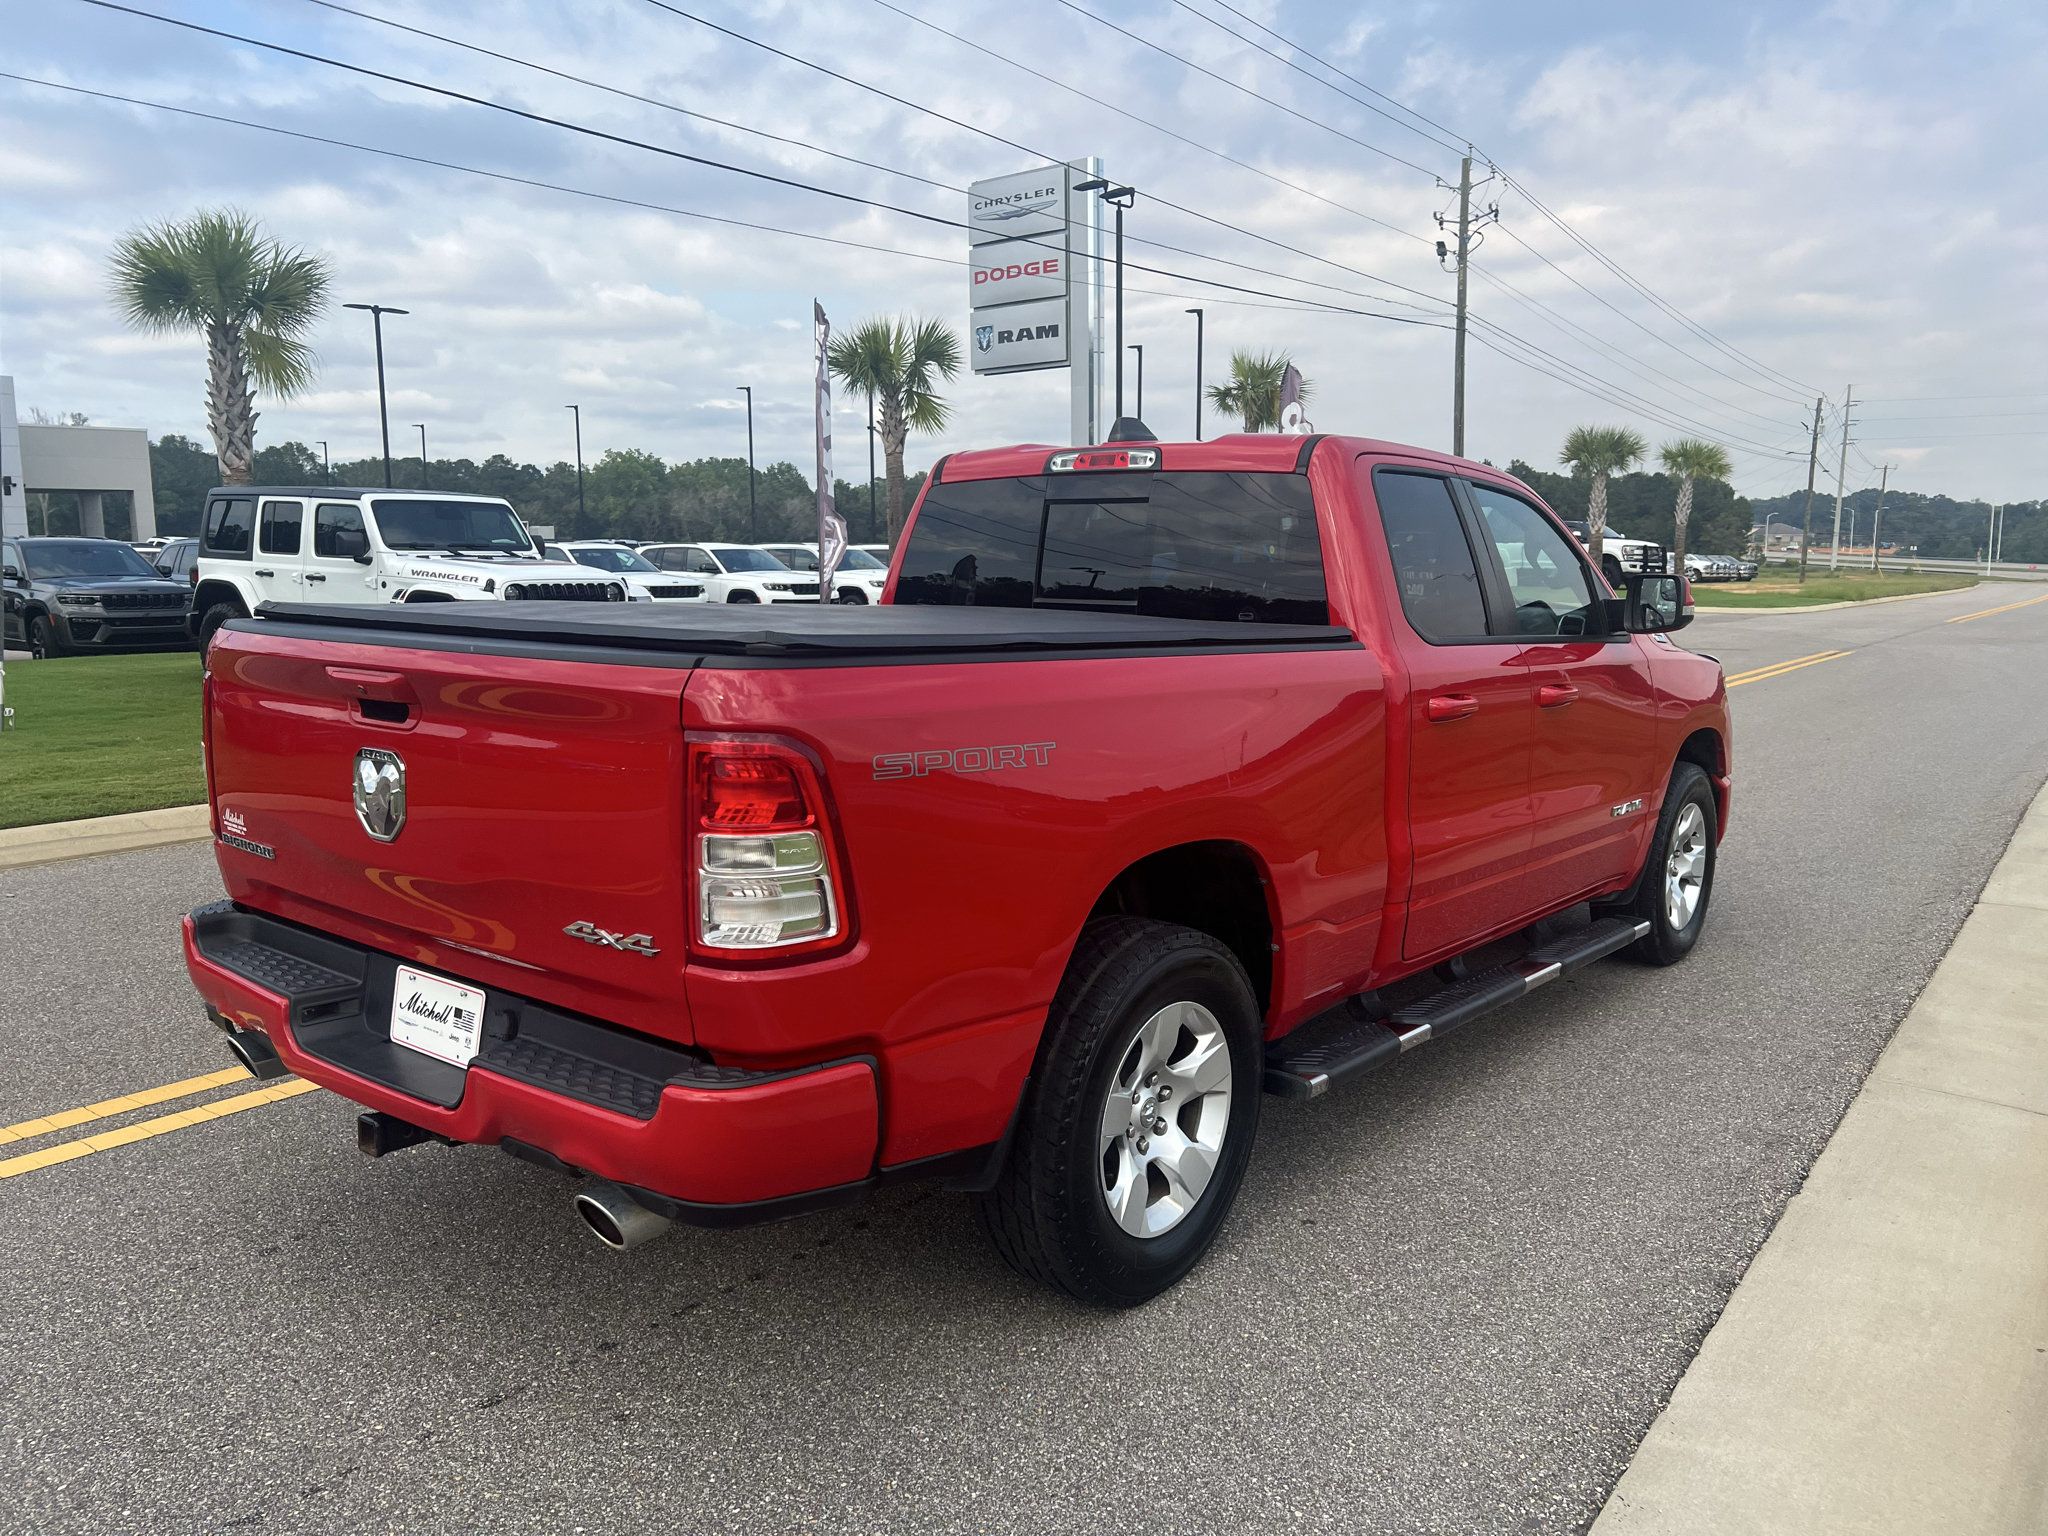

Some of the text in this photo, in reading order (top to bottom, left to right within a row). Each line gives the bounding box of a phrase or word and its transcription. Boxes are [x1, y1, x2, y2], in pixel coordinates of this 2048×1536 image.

[974, 187, 1056, 211] CHRYSLER
[974, 258, 1059, 285] DODGE
[997, 324, 1059, 345] RAM
[411, 569, 479, 583] WRANGLER
[361, 749, 393, 761] RAM
[872, 741, 1056, 780] SPORT
[222, 832, 276, 860] BIGHORN
[399, 991, 453, 1025] Mitchell
